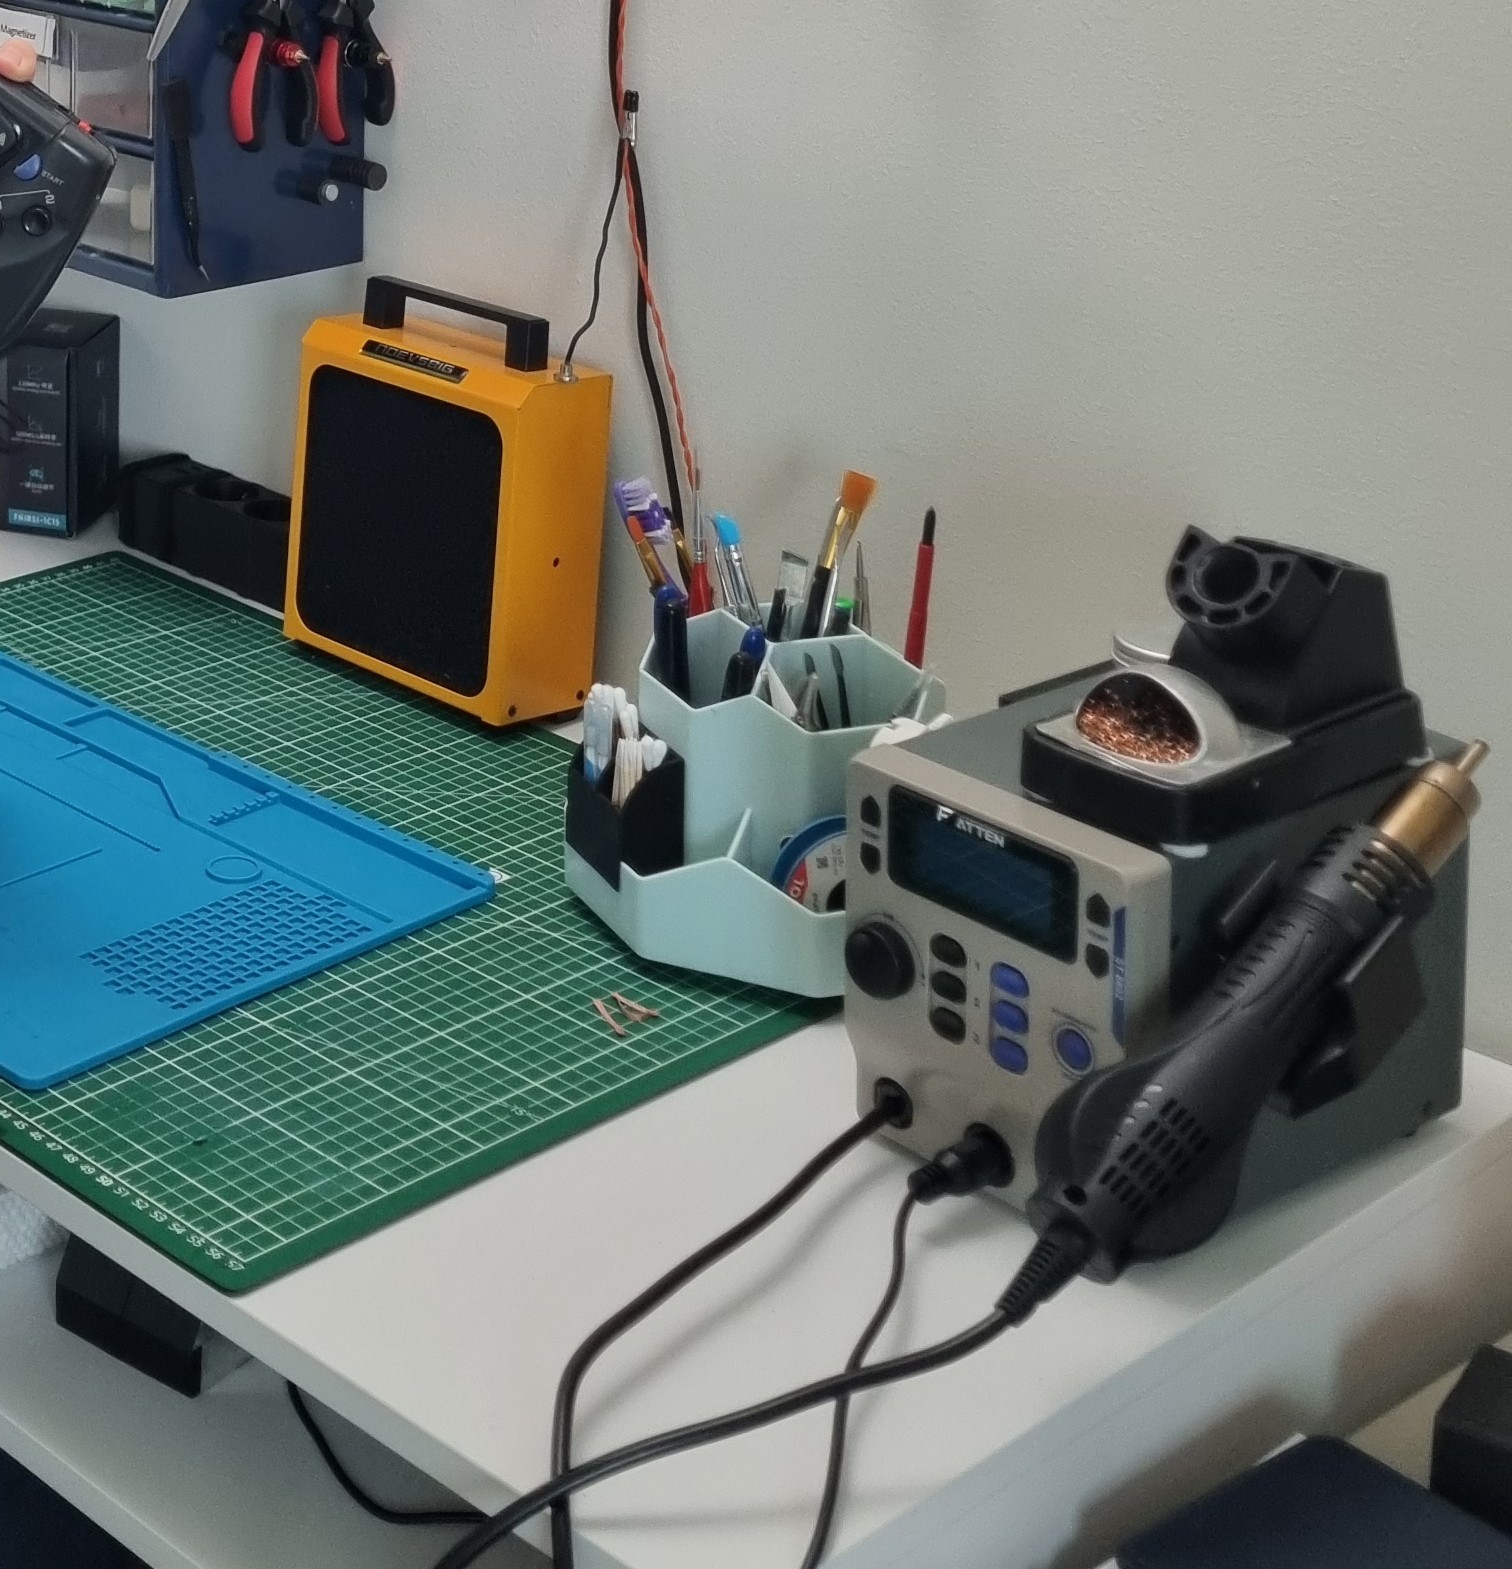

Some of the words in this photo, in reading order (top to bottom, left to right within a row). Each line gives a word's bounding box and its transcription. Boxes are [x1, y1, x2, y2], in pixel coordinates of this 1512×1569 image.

[0, 23, 37, 40] Magnetizer
[41, 170, 64, 187] START
[44, 194, 55, 205] 2
[956, 819, 1005, 848] ATTEN
[13, 1120, 29, 1130] 45
[29, 1131, 45, 1141] 46
[45, 1142, 63, 1151] 47
[62, 1153, 79, 1163] 48
[79, 1164, 96, 1174] 49
[96, 1175, 114, 1186] 50
[113, 1186, 130, 1197] 51
[131, 1198, 149, 1210] 52
[149, 1210, 168, 1222] 53
[168, 1222, 187, 1234] 54
[186, 1235, 206, 1247] 55
[204, 1248, 225, 1259] 56
[225, 1260, 245, 1271] 57
